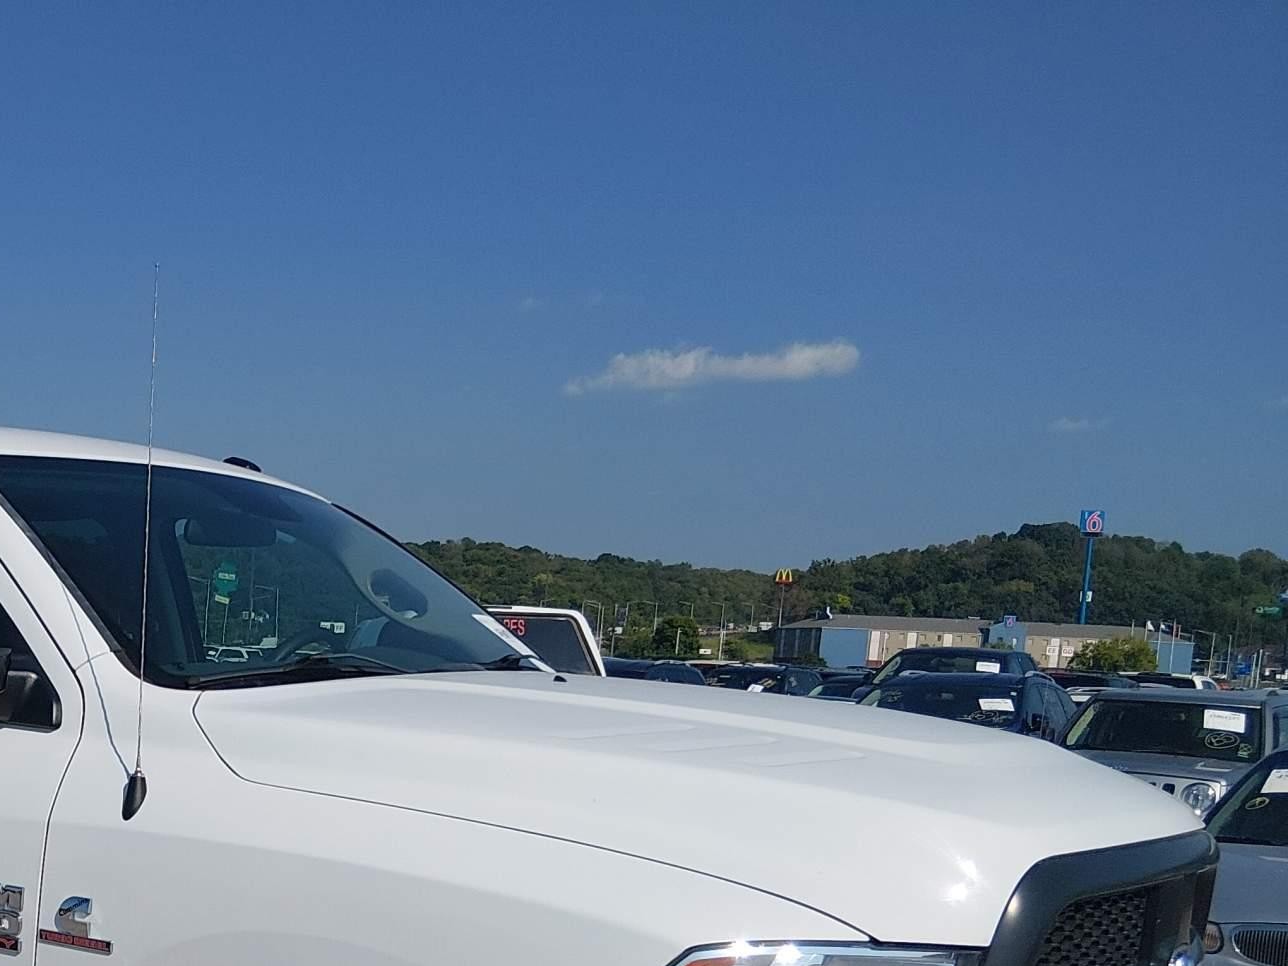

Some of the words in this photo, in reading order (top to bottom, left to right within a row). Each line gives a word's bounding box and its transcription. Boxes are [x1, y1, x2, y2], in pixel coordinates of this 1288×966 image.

[1086, 511, 1103, 532] 6
[41, 930, 73, 944] TURBO
[74, 937, 110, 951] DIESEL
